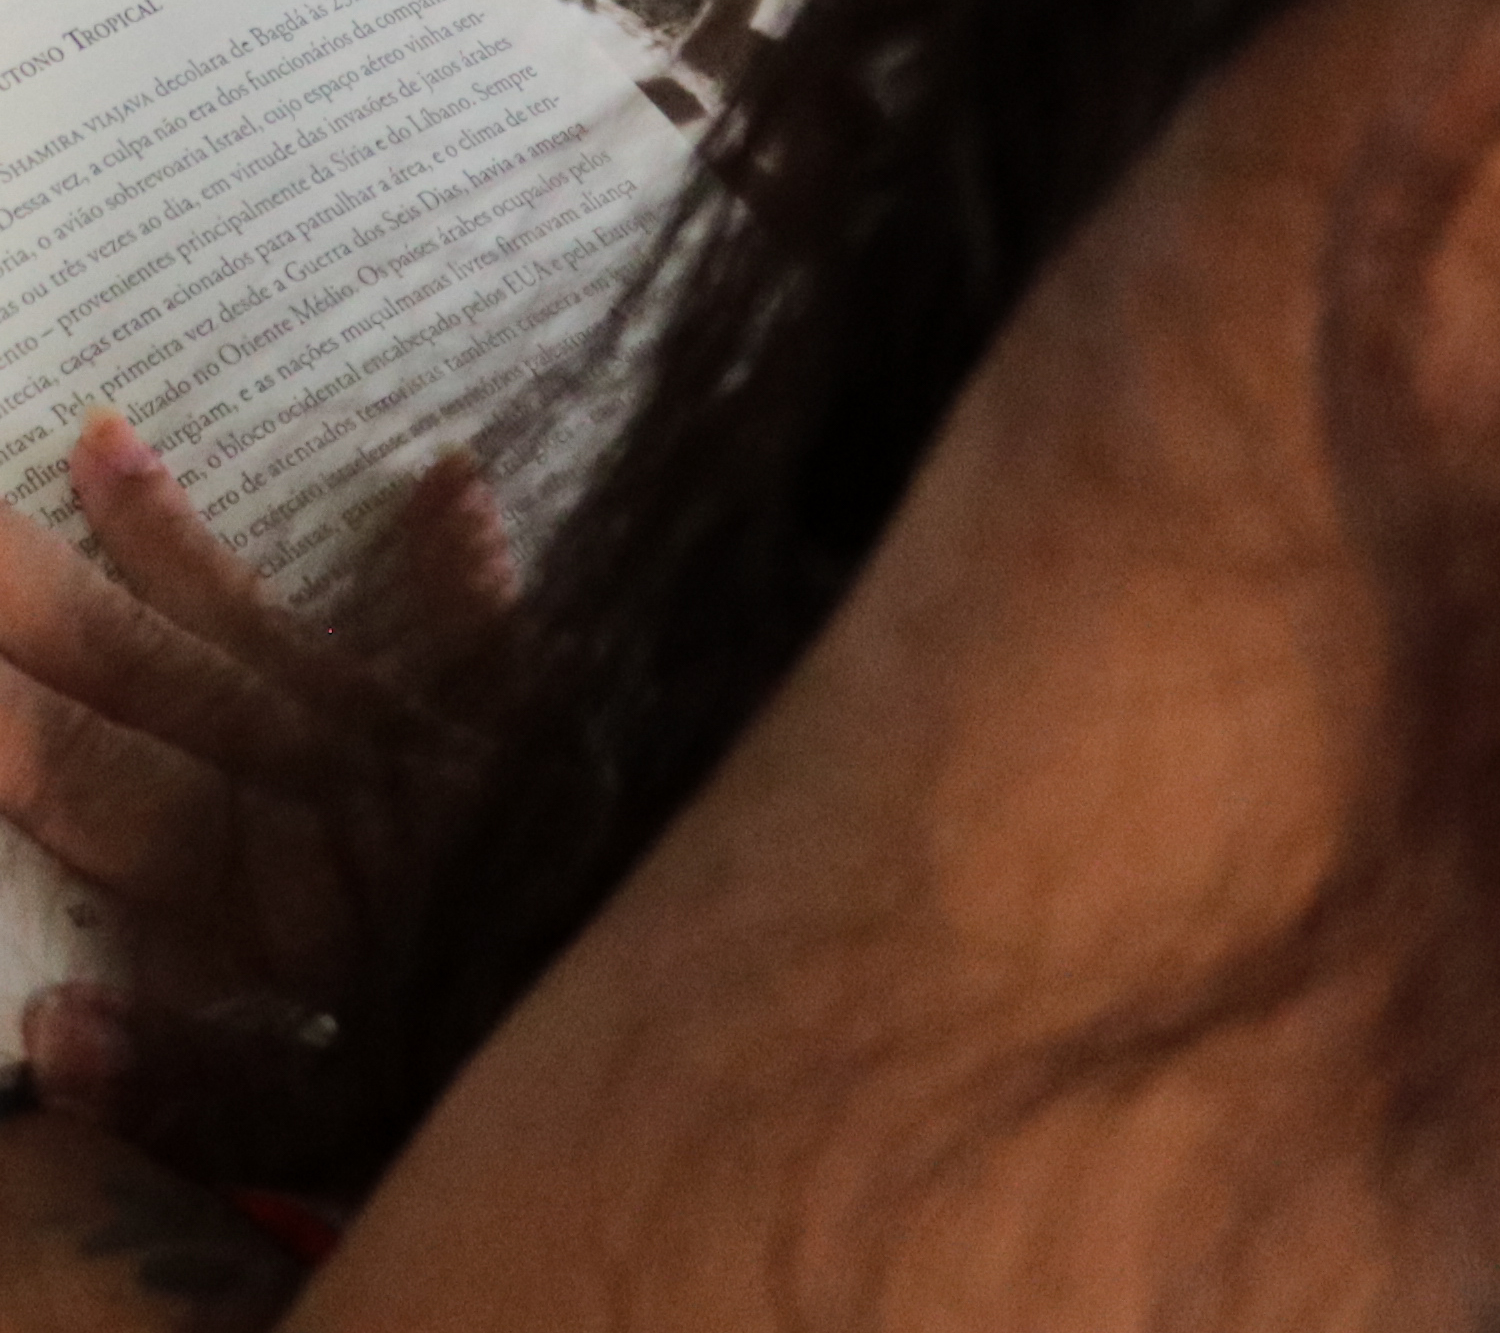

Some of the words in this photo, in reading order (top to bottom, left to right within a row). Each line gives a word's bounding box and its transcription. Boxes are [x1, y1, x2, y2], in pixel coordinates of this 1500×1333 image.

[21, 283, 49, 304] ou
[49, 259, 86, 286] três
[86, 230, 137, 262] vezes
[138, 216, 161, 235] ao
[163, 198, 200, 220] dia,
[200, 178, 231, 199] em
[230, 141, 296, 181] virtude
[296, 126, 327, 148] das
[323, 92, 398, 133] invasões
[397, 78, 421, 97] de
[416, 61, 461, 93] jatos
[459, 37, 512, 67] árabes
[37, 236, 51, 249] o
[53, 205, 103, 240] avião
[104, 148, 208, 209] sobrevoaria
[202, 114, 263, 153] Israel,
[263, 98, 302, 124] cujo
[303, 70, 359, 104] espaço
[360, 48, 404, 76] aéreo
[404, 25, 454, 52] vinha
[452, 12, 490, 32] sen-
[49, 172, 89, 195] vez,
[89, 163, 102, 175] a
[102, 135, 153, 167] culpa
[153, 117, 187, 140] não
[188, 101, 217, 120] era
[216, 84, 249, 106] dos
[245, 33, 353, 90] funcionários
[351, 19, 376, 39] da
[82, 93, 154, 131] VIAJAVA
[154, 53, 229, 96] decolara
[229, 38, 253, 58] de
[248, 9, 308, 46] Bagdá
[303, 4, 328, 20] às
